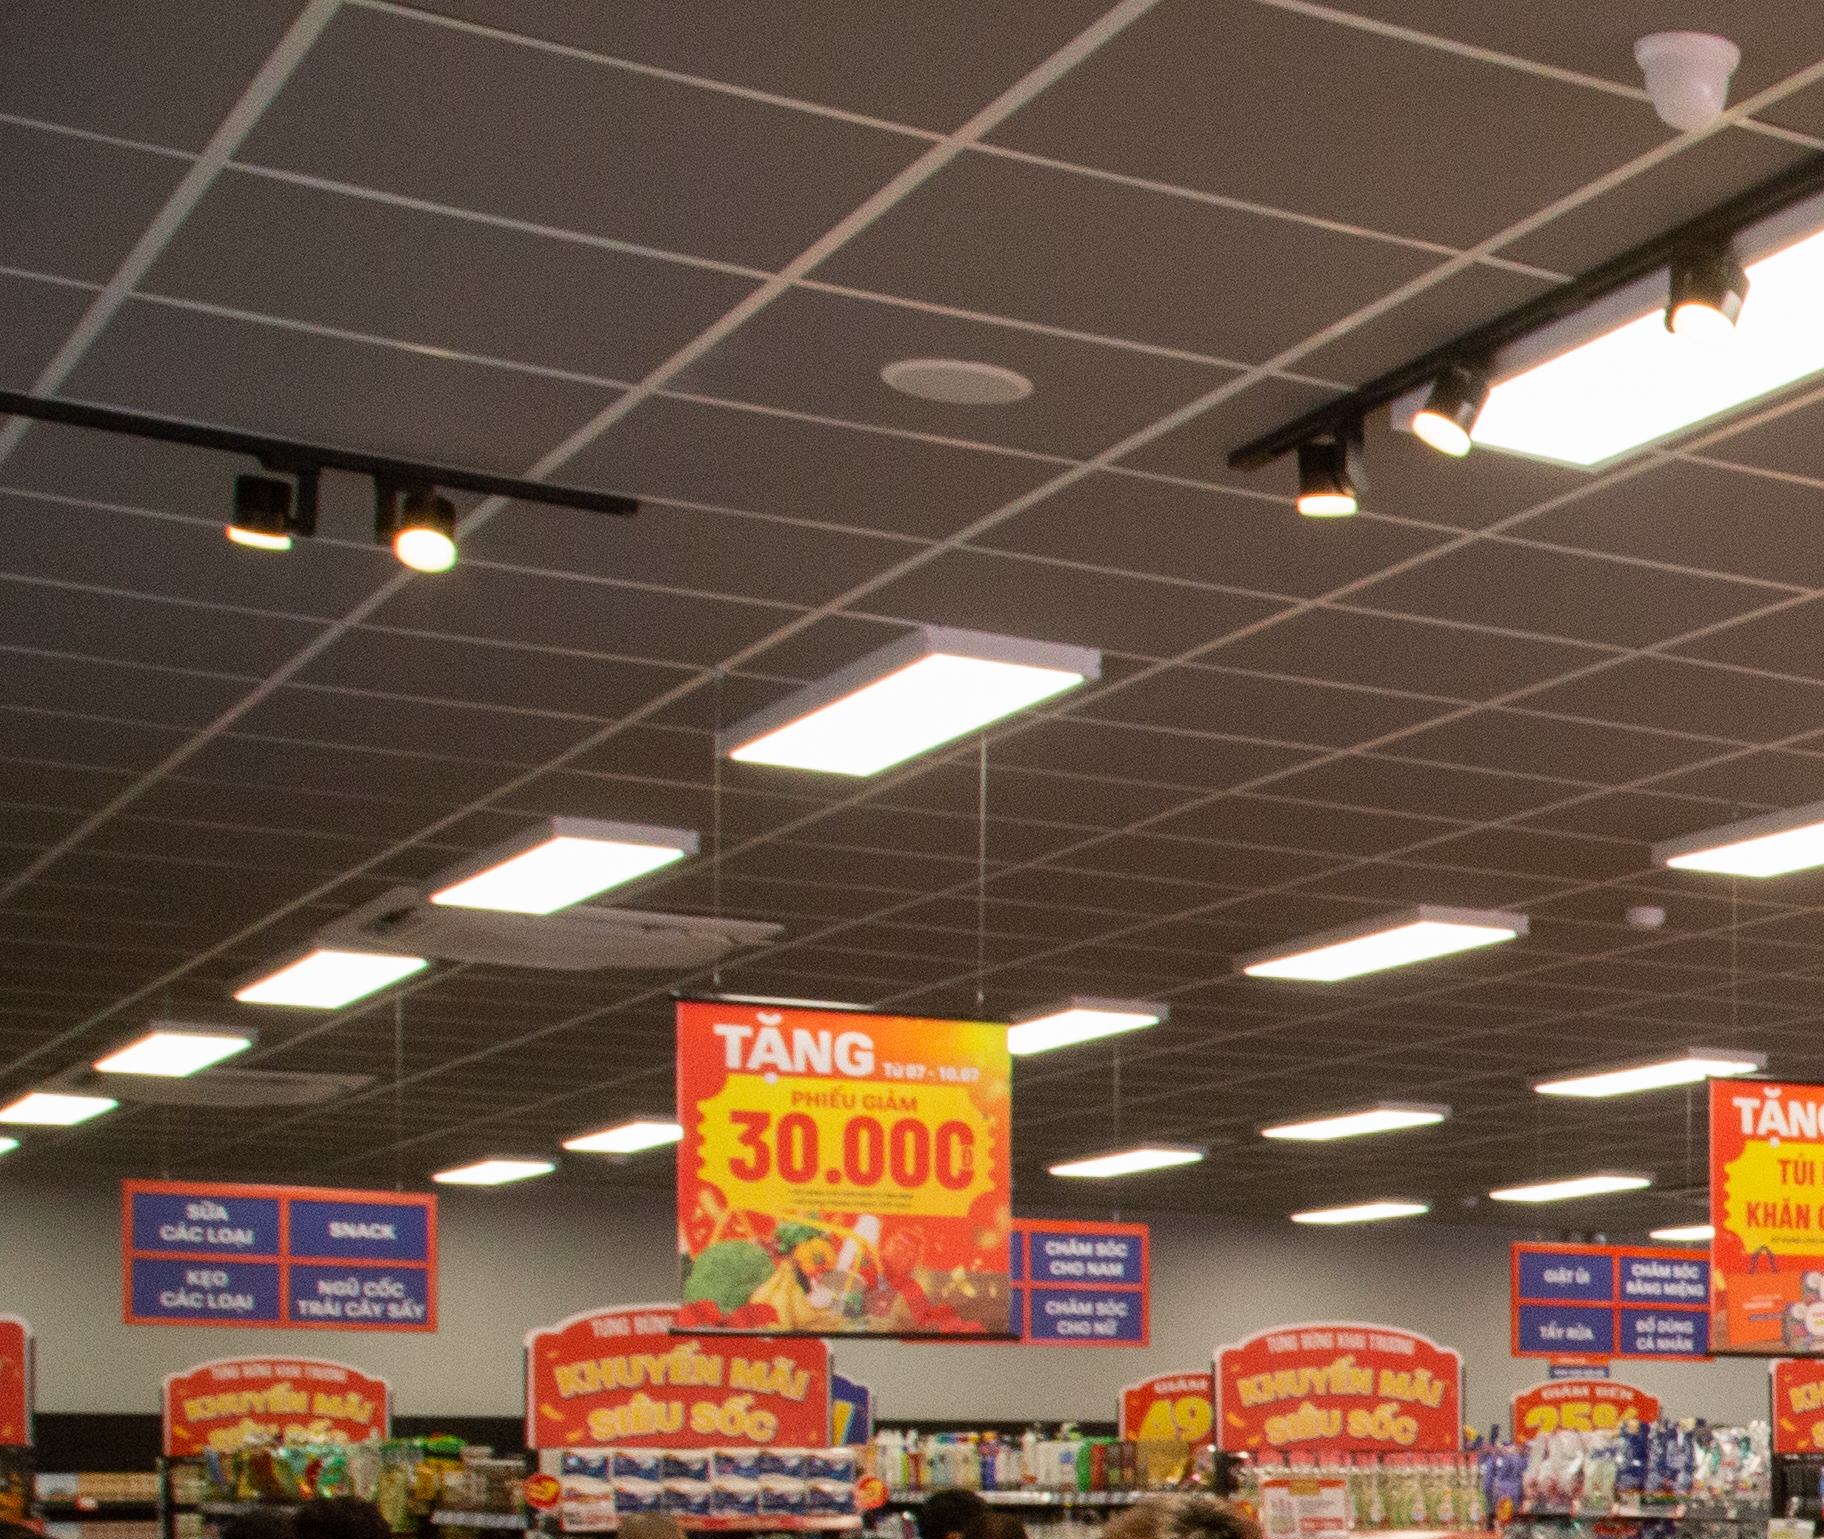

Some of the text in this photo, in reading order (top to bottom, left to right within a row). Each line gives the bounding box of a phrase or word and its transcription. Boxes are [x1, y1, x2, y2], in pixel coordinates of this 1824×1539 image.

[714, 1013, 874, 1084] TẶNG
[792, 1086, 917, 1112] PHIẾU GIẢM
[1779, 1159, 1815, 1186] TÚI
[1746, 1200, 1811, 1229] KHĂN
[329, 1222, 396, 1239] SNACK
[1051, 1261, 1124, 1277] CHO NAM
[1058, 1320, 1085, 1335] CHO
[555, 1340, 810, 1401] KHUYẾN MÃI
[1236, 1355, 1445, 1409] KHUYẾN MÃI
[588, 1393, 778, 1443] SIÊU SỐC
[1264, 1401, 1419, 1447] SIÊU SỐC
